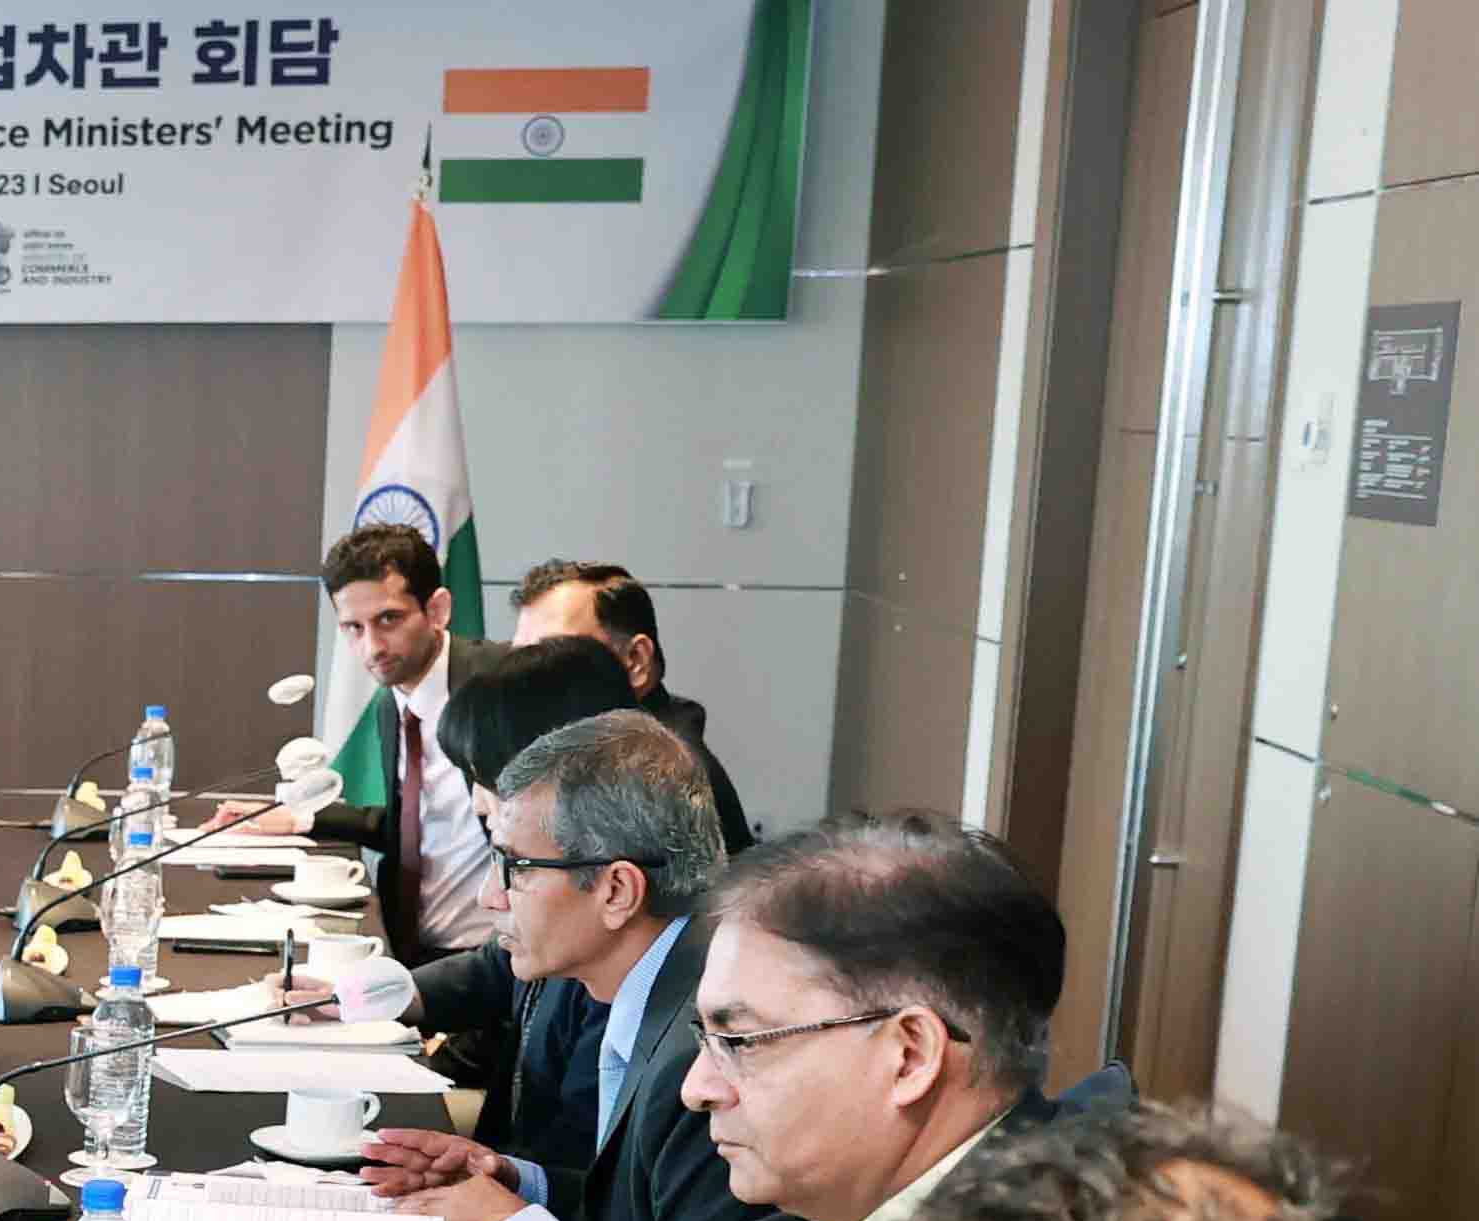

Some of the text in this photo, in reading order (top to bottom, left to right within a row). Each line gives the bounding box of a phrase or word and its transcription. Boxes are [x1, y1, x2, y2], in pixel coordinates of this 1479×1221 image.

[191, 16, 341, 88] 회담
[43, 114, 224, 149] Ministers'
[236, 112, 395, 151] Meeting
[47, 172, 125, 196] Seoul
